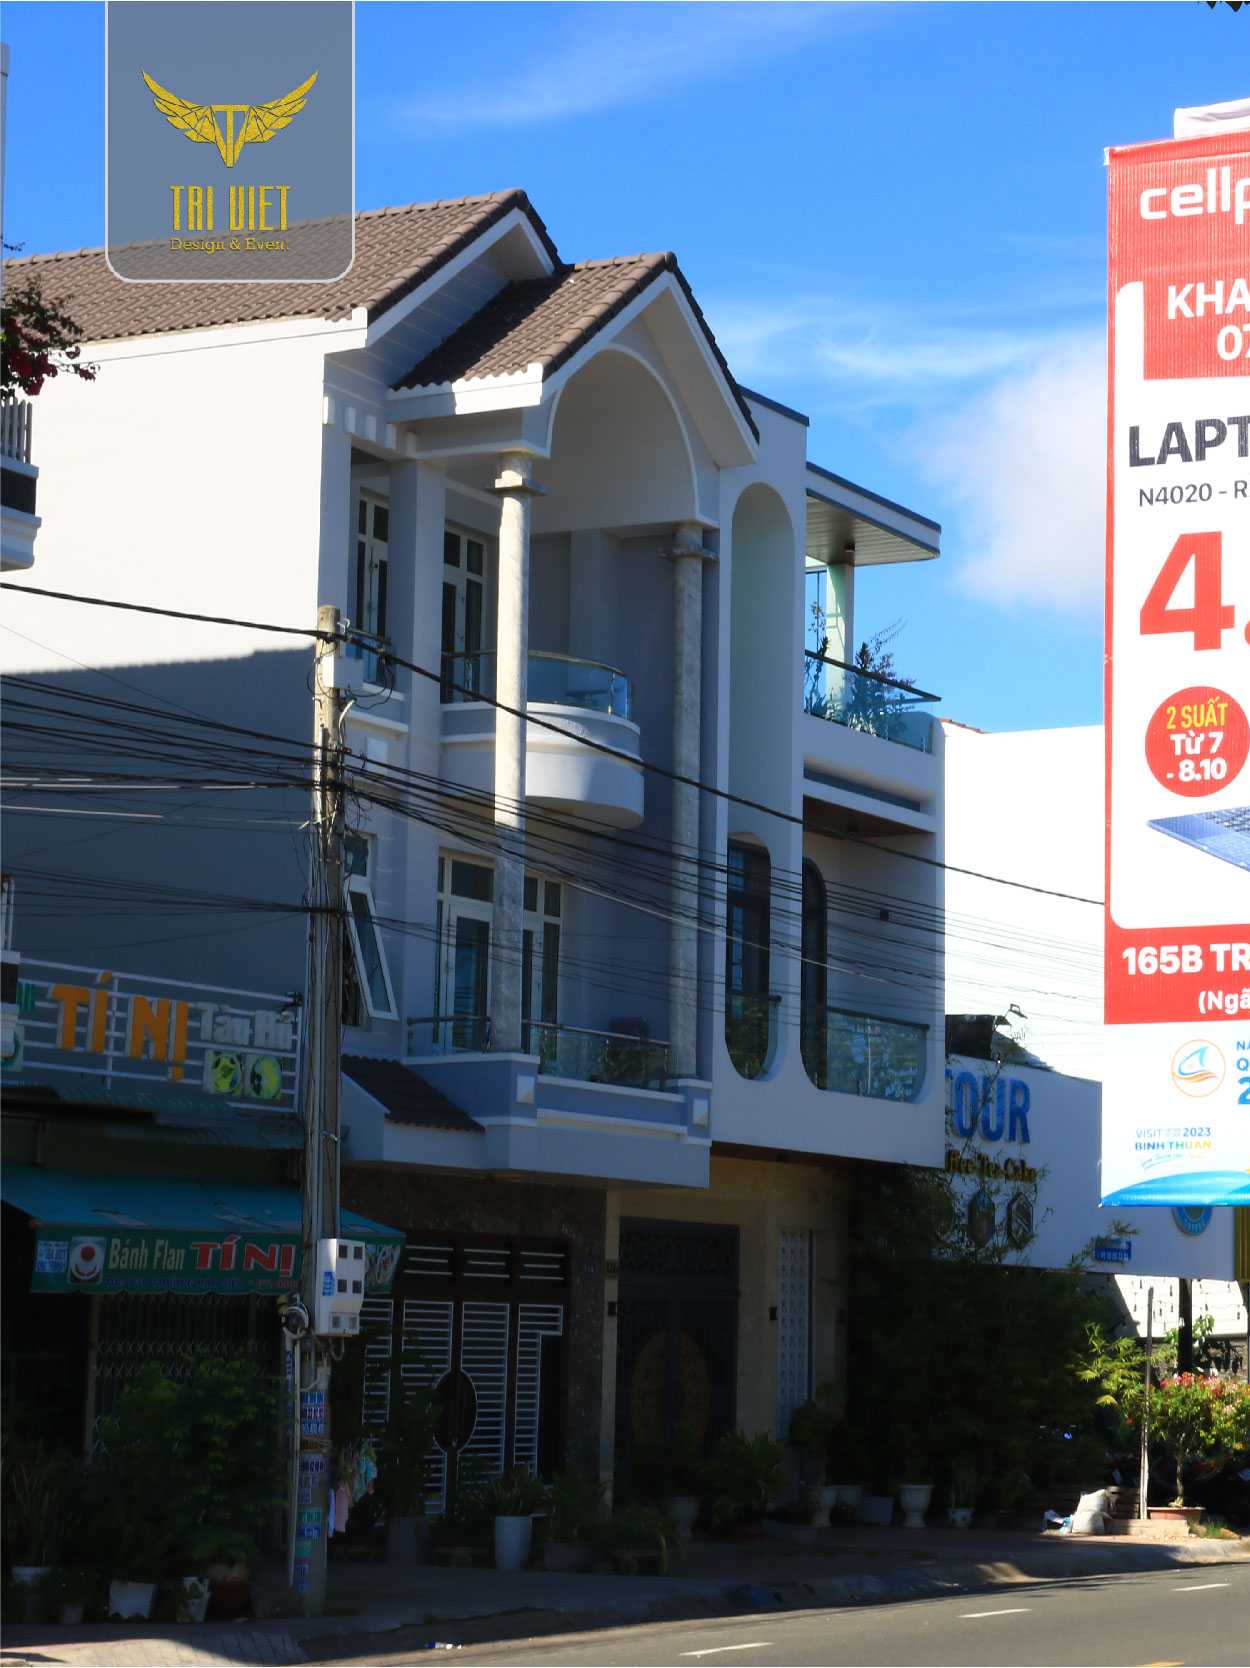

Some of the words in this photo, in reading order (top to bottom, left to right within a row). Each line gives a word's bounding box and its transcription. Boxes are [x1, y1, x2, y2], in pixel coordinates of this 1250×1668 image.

[1138, 483, 1213, 507] N4020
[1166, 706, 1176, 730] 2
[1181, 696, 1228, 729] SUẤT
[1208, 731, 1224, 754] 7
[1178, 757, 1228, 782] 8.10
[1121, 945, 1203, 976] 165B
[50, 970, 113, 1053] TÍ
[945, 1069, 1031, 1144] OUR
[1135, 1141, 1165, 1152] BINH
[1136, 1127, 1161, 1139] VISIT
[1183, 1126, 1212, 1137] 2023
[108, 1236, 150, 1271] Bánh
[152, 1238, 185, 1272] Flan
[191, 1233, 241, 1271] TÍ
[243, 1243, 296, 1278] NỊ
